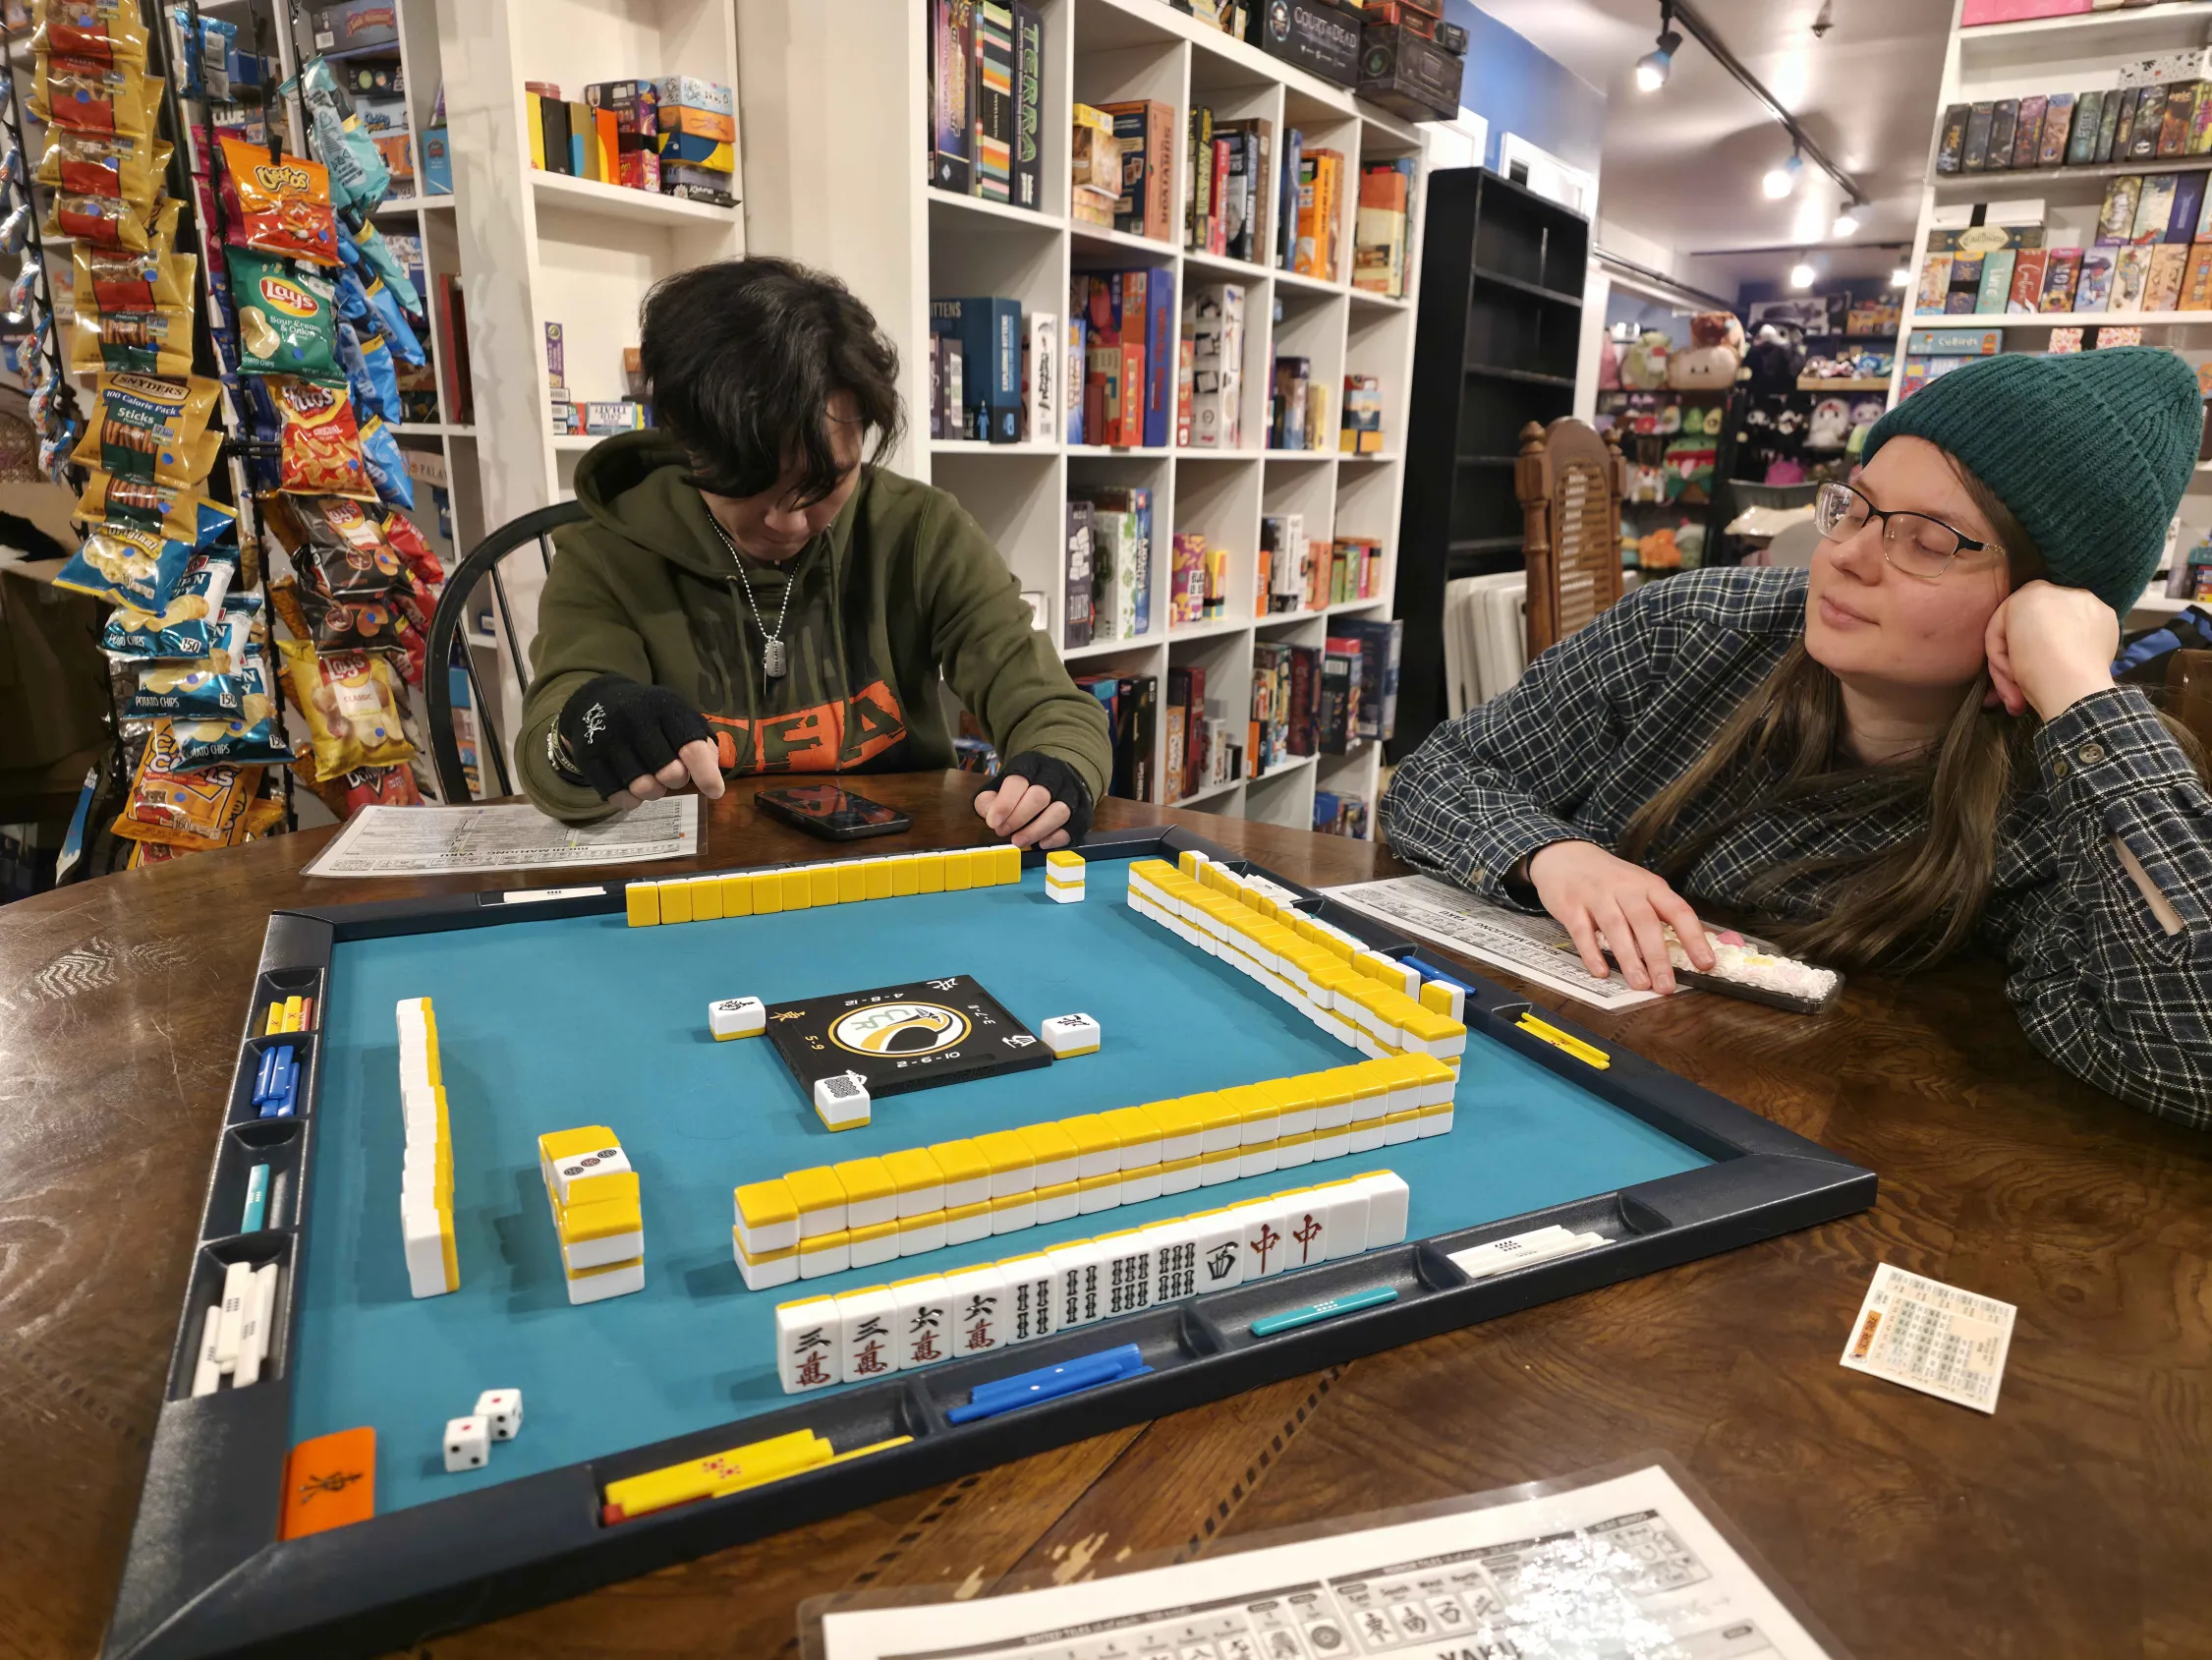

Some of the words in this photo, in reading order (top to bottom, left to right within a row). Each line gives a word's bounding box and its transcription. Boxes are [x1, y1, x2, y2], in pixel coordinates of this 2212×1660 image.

[1022, 24, 1039, 162] TERRA
[255, 165, 309, 191] Cheetos
[266, 280, 313, 309] Lay's
[931, 302, 962, 318] ITTENS
[270, 315, 292, 326] Sour
[294, 319, 321, 333] Cream
[289, 326, 315, 336] Onion
[106, 390, 121, 399] 100
[122, 394, 153, 409] Calorie
[154, 404, 177, 416] Pack
[118, 407, 154, 425] Sticks
[183, 639, 200, 651] 150
[136, 696, 159, 707] POTATO
[160, 697, 180, 708] CHIPS
[210, 744, 230, 755] CHIPS
[175, 817, 189, 830] 160
[1292, 1212, 1324, 1265] 中
[1249, 1222, 1281, 1276] 中
